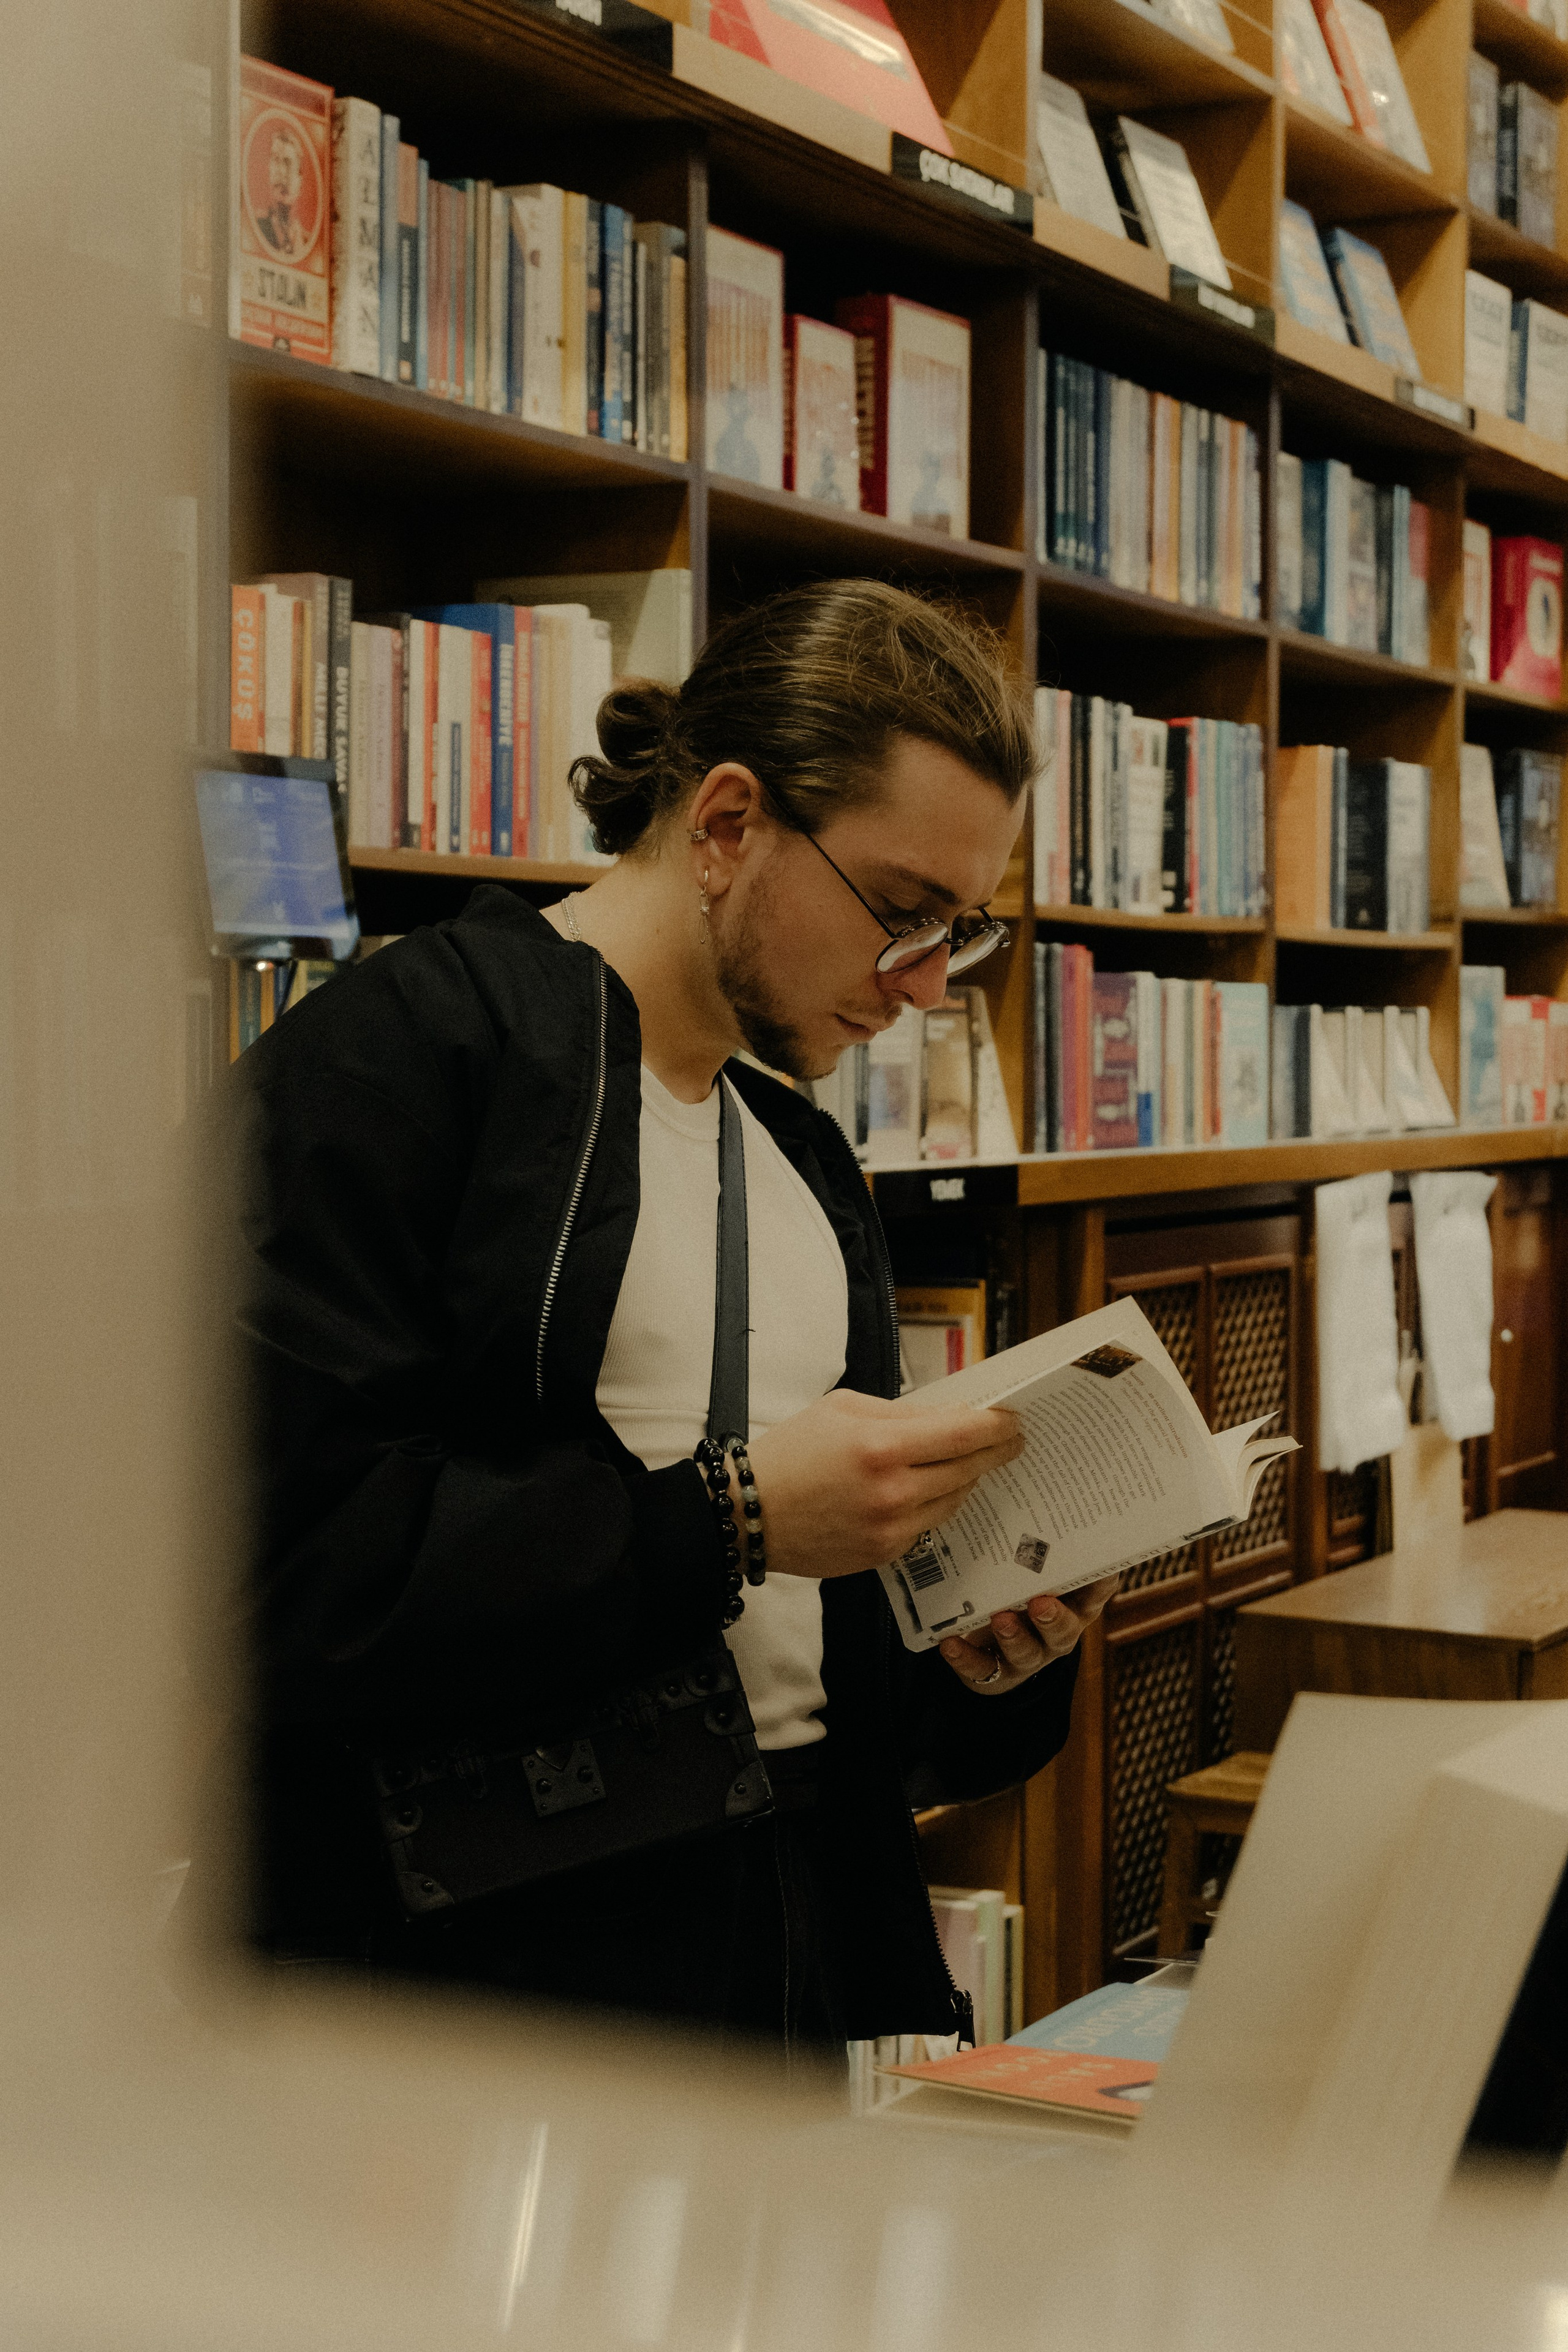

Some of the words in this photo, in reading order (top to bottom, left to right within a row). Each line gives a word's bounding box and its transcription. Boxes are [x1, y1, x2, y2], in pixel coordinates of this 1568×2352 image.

[1086, 1401, 1096, 1410] and
[1093, 1409, 1104, 1420] make
[1102, 1421, 1119, 1441] civilised
[1137, 1481, 1146, 1497] Mark
[1091, 1393, 1110, 1413] instability
[1112, 1418, 1125, 1434] which
[1128, 1443, 1139, 1460] forces
[1139, 1467, 1157, 1502] nationalism
[1108, 1398, 1123, 1414] become
[1124, 1417, 1138, 1437] byword
[1140, 1446, 1156, 1474] vengeance,
[1154, 1476, 1166, 1496] hatred
[1129, 1398, 1144, 1417] Literary
[1143, 1417, 1163, 1449] Supplement
[1131, 1387, 1144, 1400] region
[1147, 1408, 1156, 1417] the
[1152, 1417, 1168, 1437] general
[1153, 1398, 1169, 1422] excellent
[1167, 1422, 1188, 1458] introduction
[1027, 1428, 1046, 1449] Stretching
[1043, 1447, 1054, 1460] from
[1057, 1469, 1066, 1479] fall
[1066, 1485, 1088, 1528] Constantinople
[1030, 1445, 1041, 1457] right
[1038, 1456, 1046, 1464] up
[1051, 1480, 1066, 1502] present,
[1069, 1513, 1078, 1529] book
[1042, 1431, 1054, 1444] forces
[1052, 1444, 1061, 1454] that
[1059, 1454, 1068, 1466] have
[1066, 1466, 1080, 1486] shaped
[1087, 1508, 1097, 1525] death
[1055, 1419, 1071, 1436] through
[1089, 1469, 1100, 1490] Monks,
[1098, 1490, 1112, 1515] peasants,
[1060, 1440, 1078, 1466] Christians,
[1077, 1466, 1091, 1490] Muslims
[1088, 1490, 1098, 1502] and
[1093, 1502, 1102, 1515] Jews
[1065, 1405, 1085, 1425] stereotypes
[1083, 1425, 1093, 1435] and
[1090, 1434, 1112, 1469] demonstrates
[1112, 1474, 1126, 1498] through
[1069, 1422, 1081, 1435] many
[1079, 1434, 1092, 1452] diverse
[1090, 1452, 1109, 1483] inhabitants
[1108, 1488, 1117, 1501] how
[1114, 1501, 1123, 1516] daily
[1096, 1427, 1106, 1438] new
[1103, 1438, 1117, 1457] history
[1114, 1457, 1126, 1475] allows
[1123, 1474, 1129, 1483] us
[1128, 1490, 1137, 1500] get
[960, 1509, 973, 1528] reliable
[970, 1528, 977, 1536] or
[976, 1540, 986, 1556] more
[964, 1498, 974, 1513] know
[972, 1512, 982, 1526] little
[979, 1526, 987, 1534] of
[988, 1545, 999, 1566] history
[970, 1492, 987, 1516] masterful
[984, 1516, 993, 1528] and
[990, 1528, 1007, 1562] wonderfully
[979, 1488, 1000, 1521] illuminating
[997, 1520, 1017, 1556] information,
[1011, 1477, 1021, 1488] and
[1029, 1508, 1044, 1533] standard
[1017, 1459, 1033, 1479] exciting
[1031, 1478, 1041, 1491] than
[1038, 1491, 1045, 1500] we
[1042, 1499, 1051, 1512] ever
[1048, 1512, 1063, 1540] imagined
[1039, 1474, 1057, 1503] soundbites
[1057, 1510, 1069, 1528] reveal
[1061, 1561, 1133, 1591] Balkans
